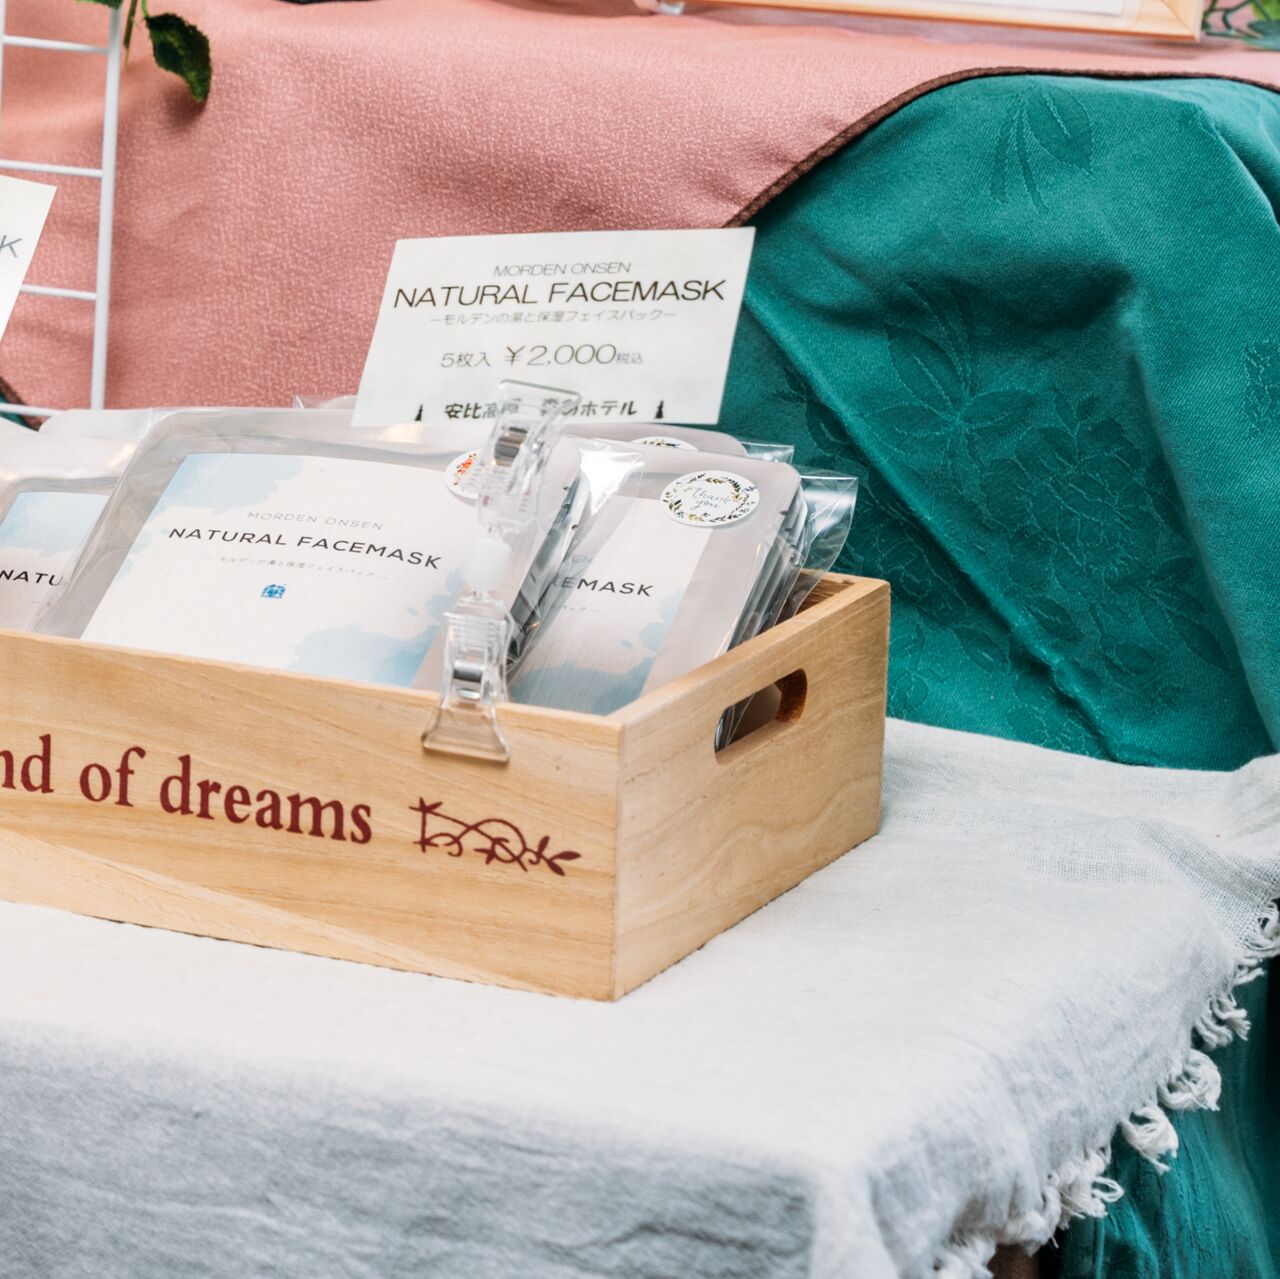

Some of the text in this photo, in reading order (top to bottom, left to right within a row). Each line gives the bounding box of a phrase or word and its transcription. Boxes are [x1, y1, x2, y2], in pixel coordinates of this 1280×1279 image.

[493, 261, 632, 278] MORDEN ONSEN
[393, 278, 728, 309] NATURAL FACEMASK
[246, 511, 384, 532] MORDEN ONSEN
[168, 527, 444, 570] NATURAL FACEMASK
[79, 744, 148, 807] of
[159, 752, 375, 846] dreams
